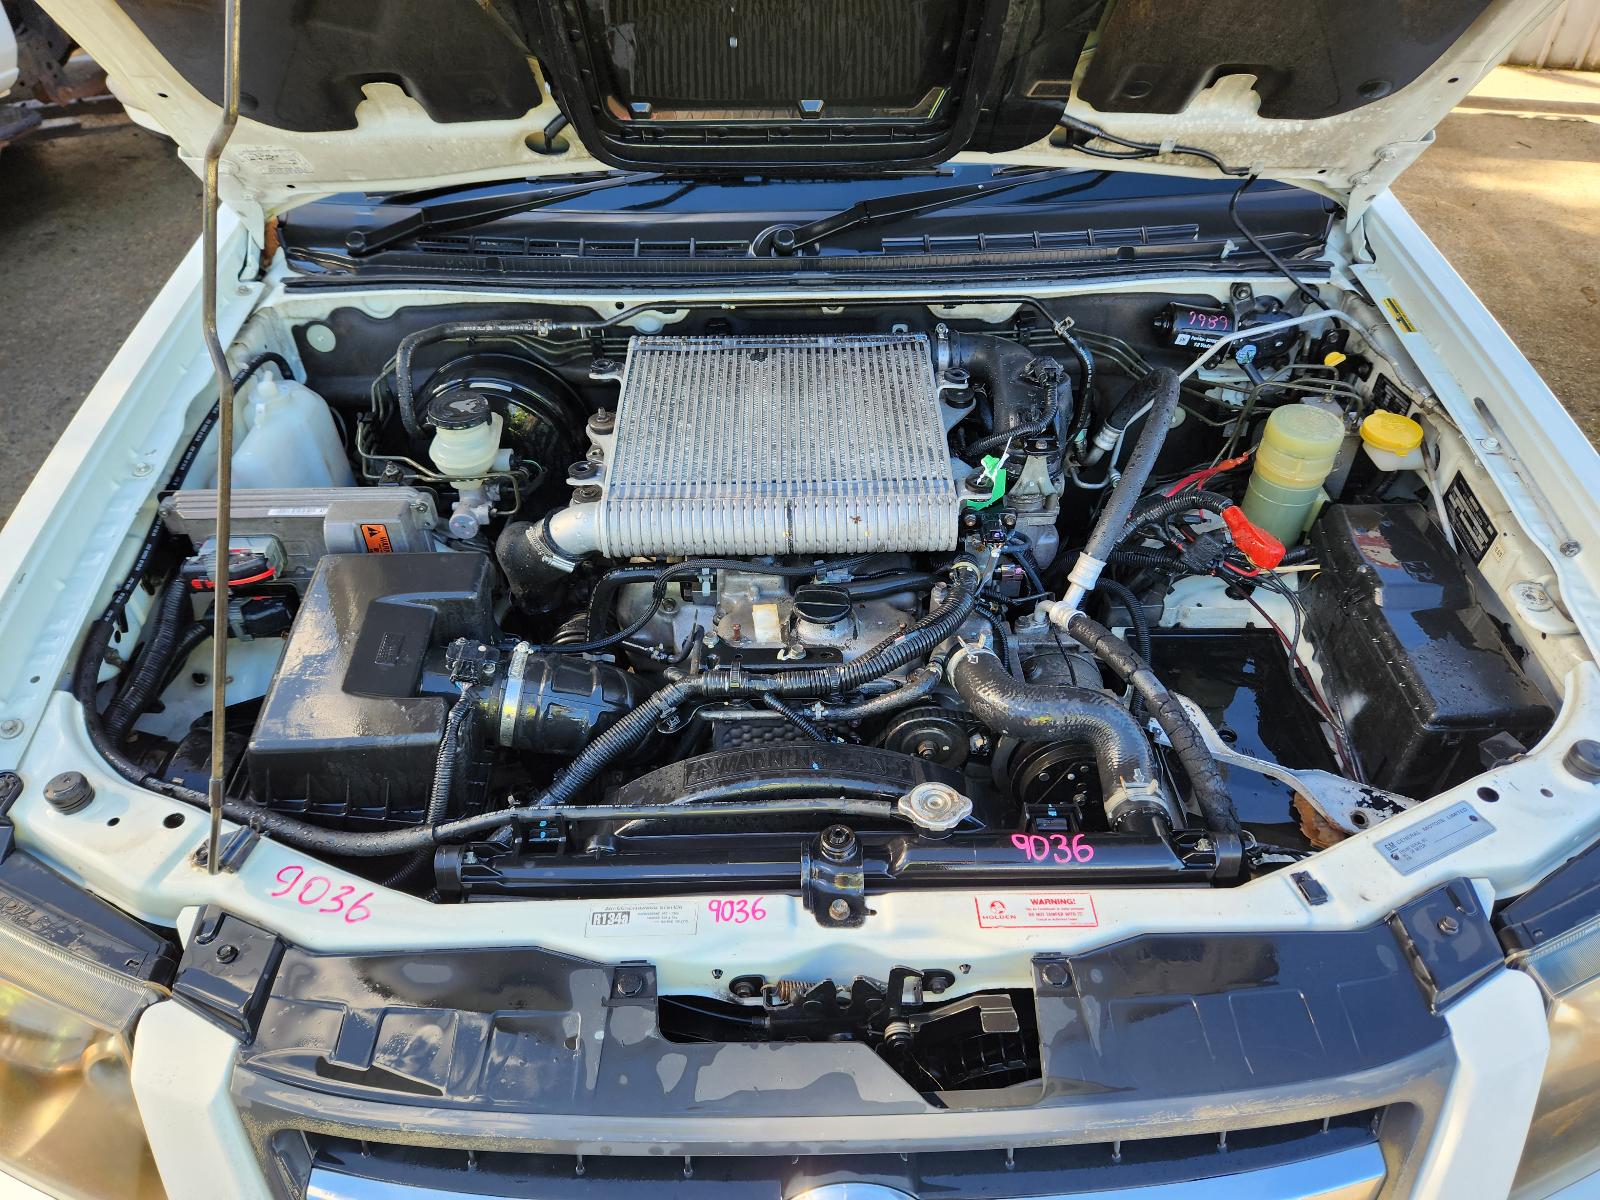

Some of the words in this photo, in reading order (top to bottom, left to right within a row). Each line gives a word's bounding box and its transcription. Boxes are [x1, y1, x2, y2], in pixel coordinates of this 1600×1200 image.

[1011, 833, 1094, 863] 9036
[271, 866, 374, 923] 9036
[708, 896, 766, 923] 9036
